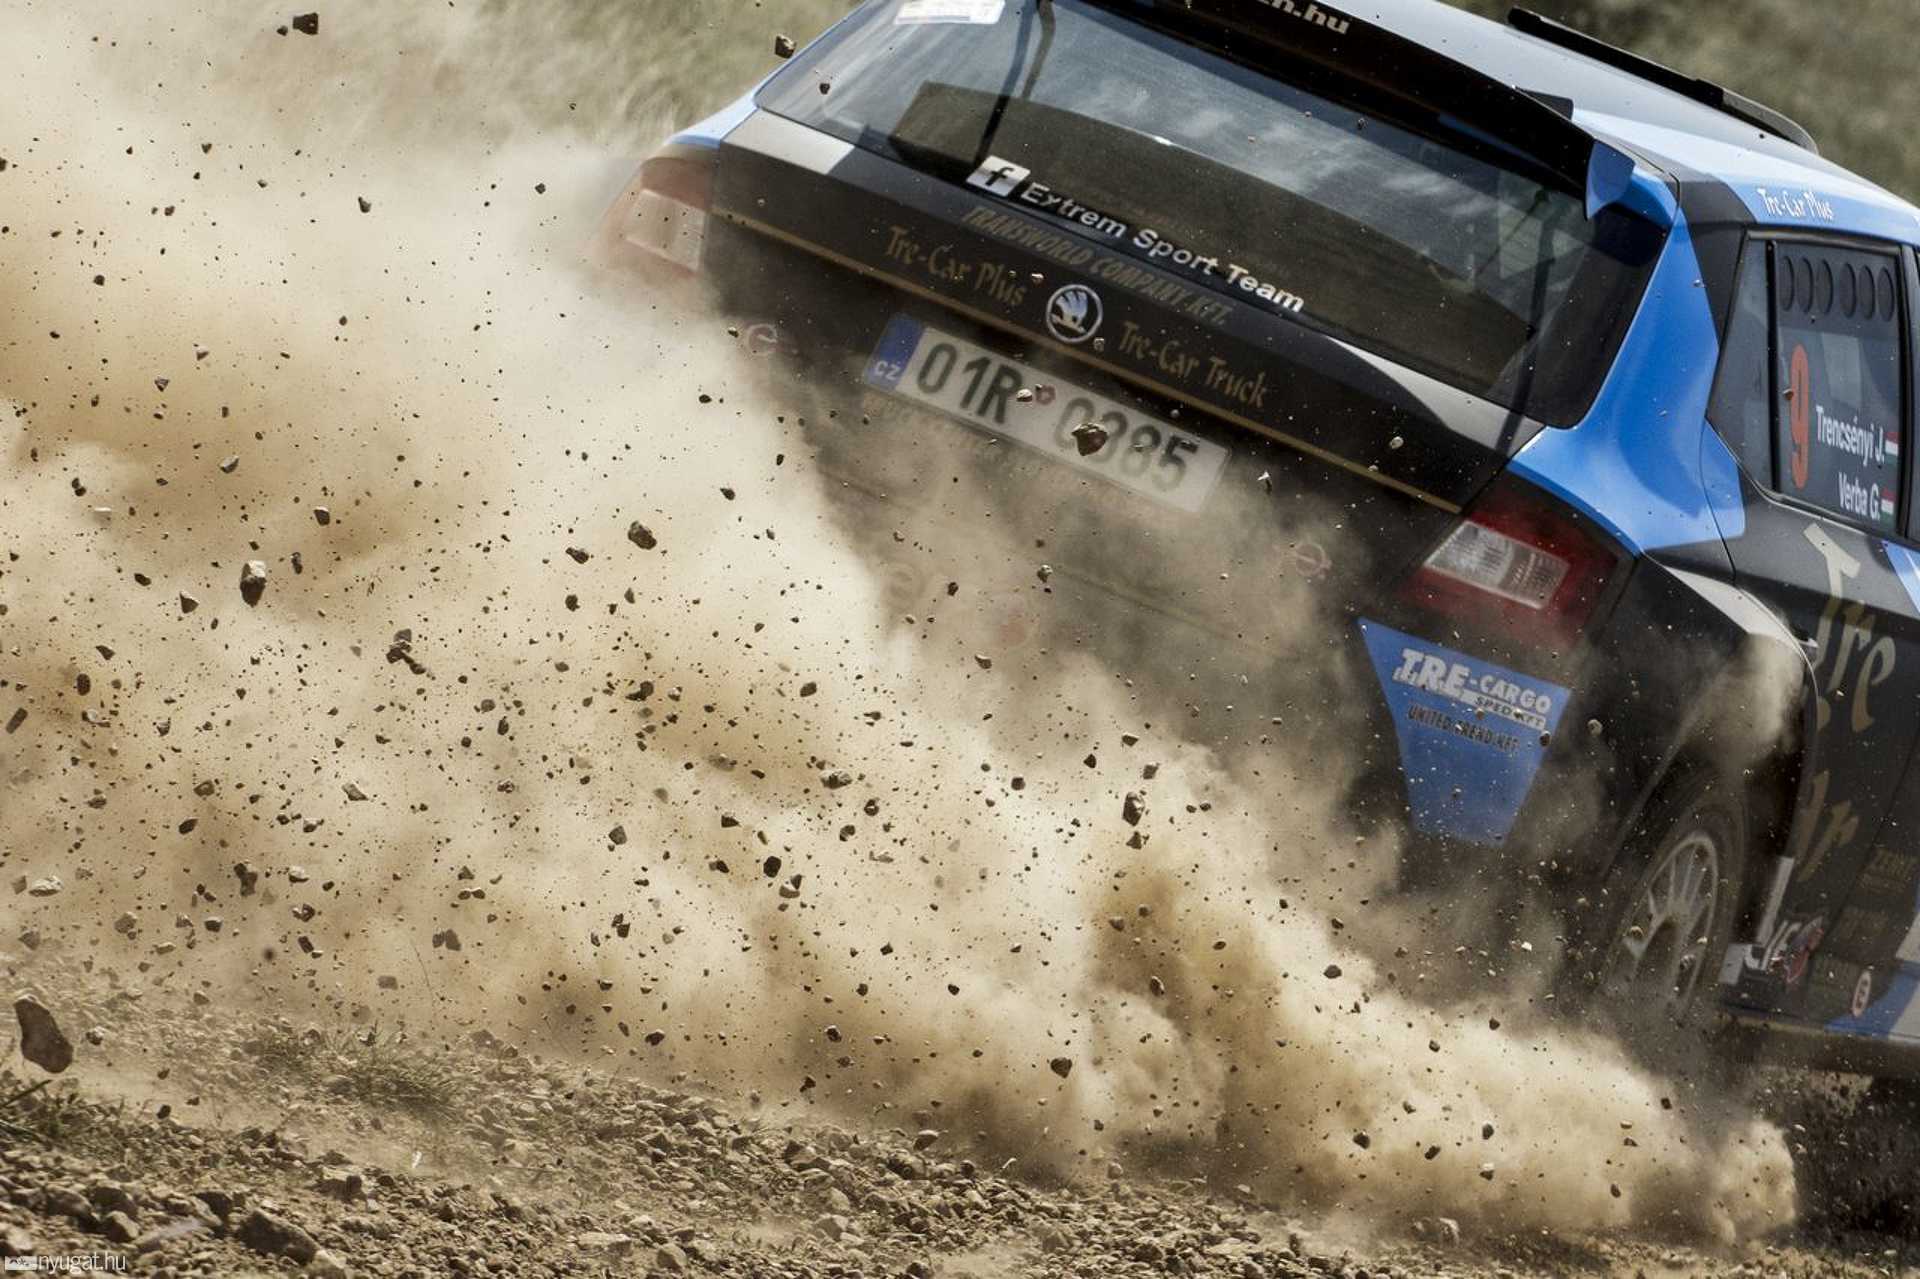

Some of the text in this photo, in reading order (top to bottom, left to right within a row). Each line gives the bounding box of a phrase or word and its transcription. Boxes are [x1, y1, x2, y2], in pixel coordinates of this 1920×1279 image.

[886, 225, 1027, 306] Tre-Car Plus
[961, 207, 1092, 266] TRANSWORLD
[1089, 257, 1194, 306] COMPANY
[1020, 182, 1127, 239] Extrem
[1132, 228, 1219, 275] Sport
[1226, 263, 1305, 312] Team
[873, 360, 901, 382] CZ
[1119, 320, 1267, 408] Tre-Car Truck
[1791, 344, 1809, 490] 9
[1838, 471, 1868, 516] Verba
[1475, 695, 1513, 716] SPED
